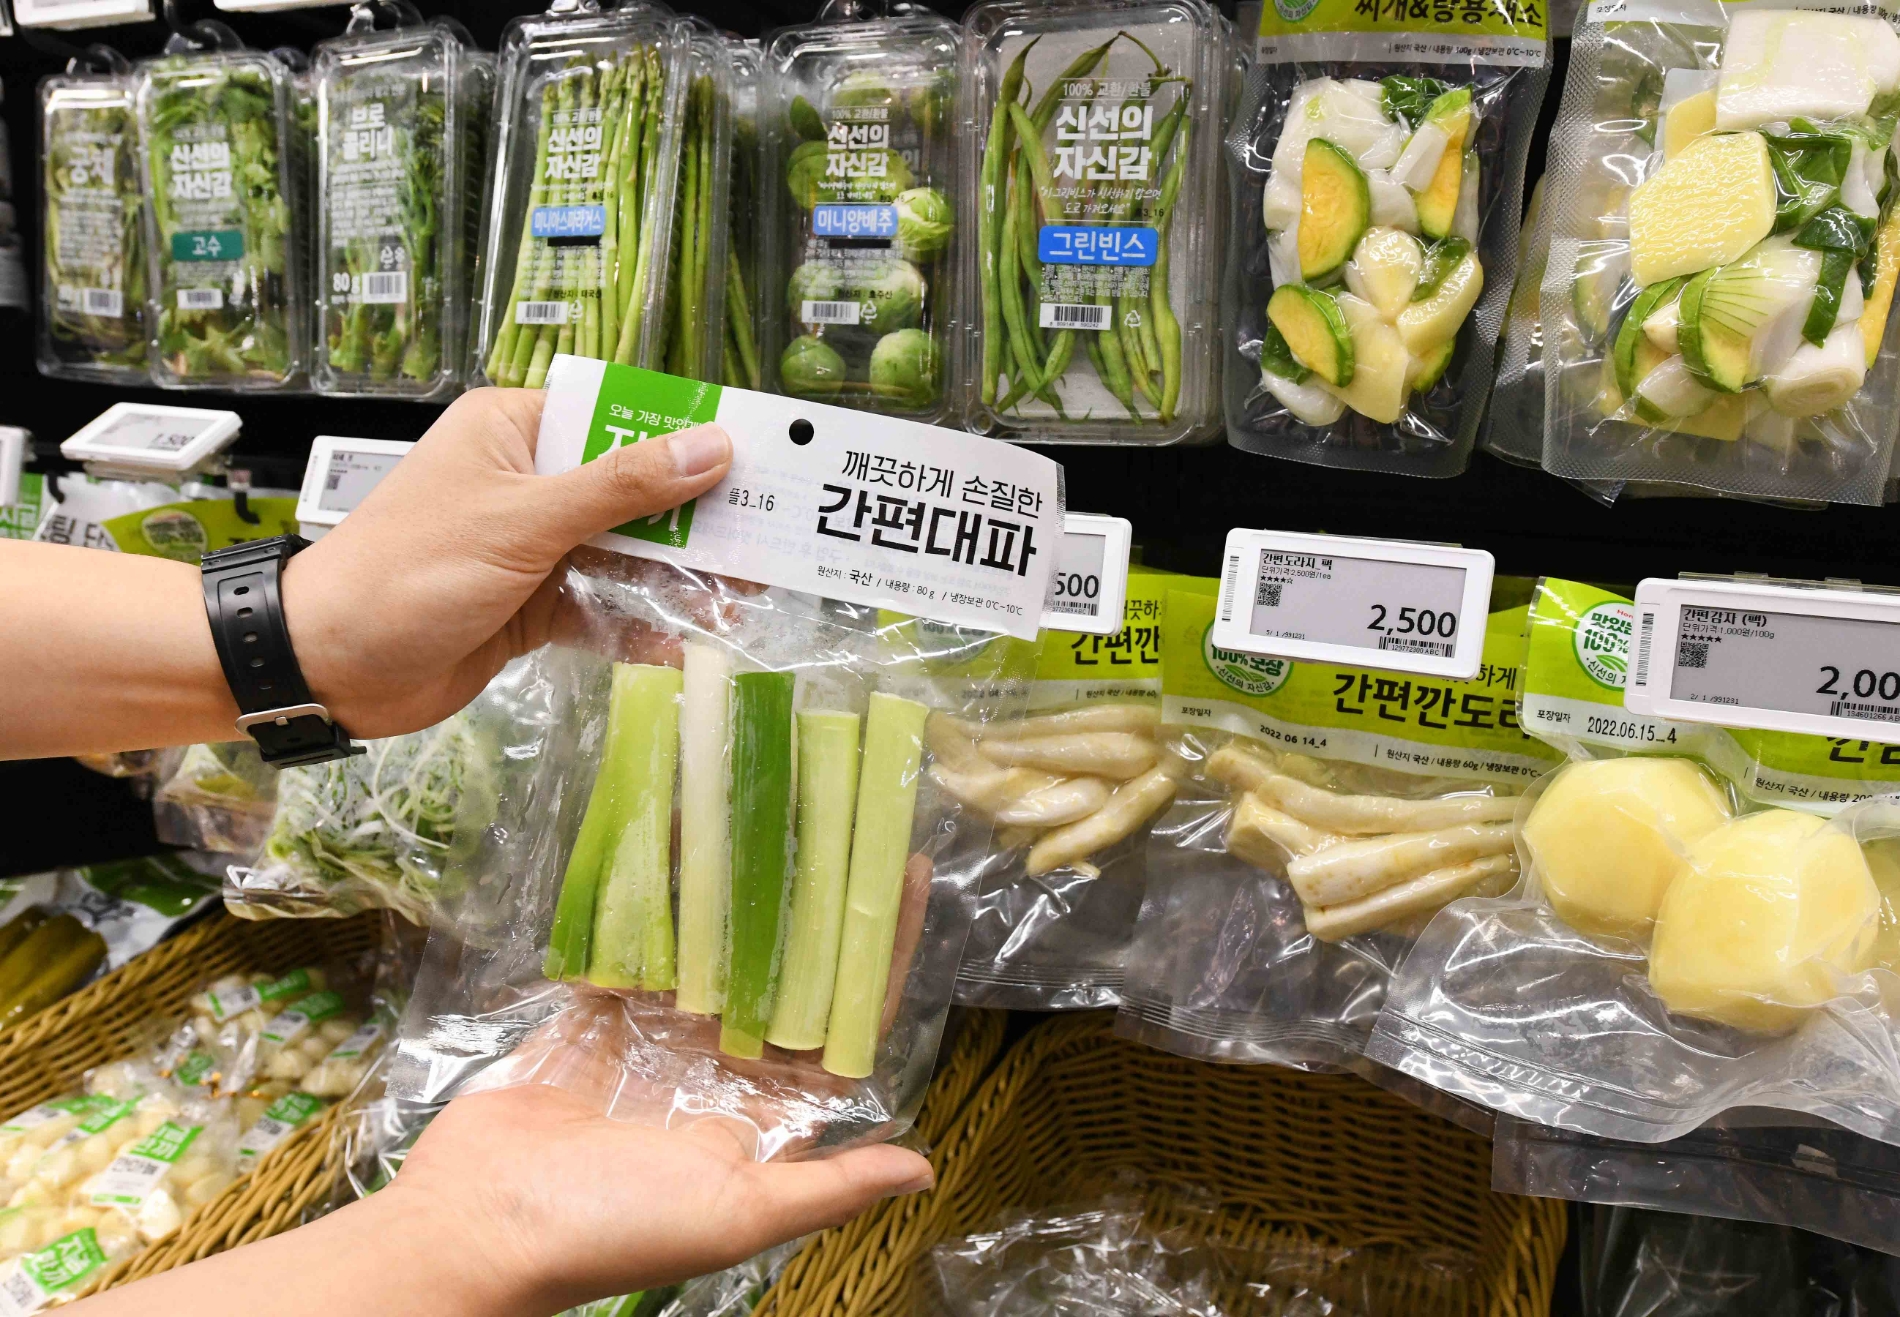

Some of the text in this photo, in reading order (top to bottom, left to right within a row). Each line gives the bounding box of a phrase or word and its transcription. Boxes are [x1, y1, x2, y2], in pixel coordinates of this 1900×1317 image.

[1063, 81, 1151, 98] 100% 교환/환불
[351, 103, 385, 130] 브로
[1055, 105, 1154, 140] 신선의
[342, 125, 394, 161] 콜리니
[548, 126, 603, 153] 신선의
[827, 124, 890, 150] 신선의
[170, 142, 230, 172] 신선의
[545, 153, 601, 179] 자신감
[825, 152, 890, 178] 자신감
[1053, 146, 1153, 180] 자신감
[171, 170, 233, 199] 자신감
[817, 209, 894, 234] 미니양배추
[191, 233, 223, 258] 고수
[1048, 230, 1146, 261] 그린빈스
[609, 404, 634, 420] 오늘
[636, 410, 661, 426] 가장
[842, 451, 1043, 519] 깨끗하게 손질한
[817, 484, 1037, 577] 간편대파
[817, 565, 841, 577] 원산지
[849, 569, 873, 587] 국산
[885, 579, 910, 594] 내용량
[950, 591, 983, 607] 냉장보관
[1366, 604, 1458, 638] 2,500
[1683, 608, 1768, 628] 간편감자 (팩)
[1424, 648, 1440, 656] ABC
[1583, 627, 1629, 654] 100%
[1217, 667, 1273, 693] 신선의 자신감
[1587, 660, 1617, 685] 신선의
[1181, 706, 1212, 718] 포장일자
[1536, 709, 1571, 724] 포장일자
[1846, 710, 1887, 721] 134601266
[1259, 724, 1327, 749] 2022 06 14_4
[1586, 716, 1677, 744] 2022.06.15_4
[1386, 748, 1410, 763] 원산지
[1412, 754, 1430, 766] 국산
[1436, 757, 1461, 770] 내용량
[1462, 760, 1479, 772] 60g
[1486, 761, 1520, 776] 냉장보관
[1755, 776, 1786, 793] 원산지
[1788, 785, 1810, 798] 국산
[1818, 791, 1850, 803] 내용량
